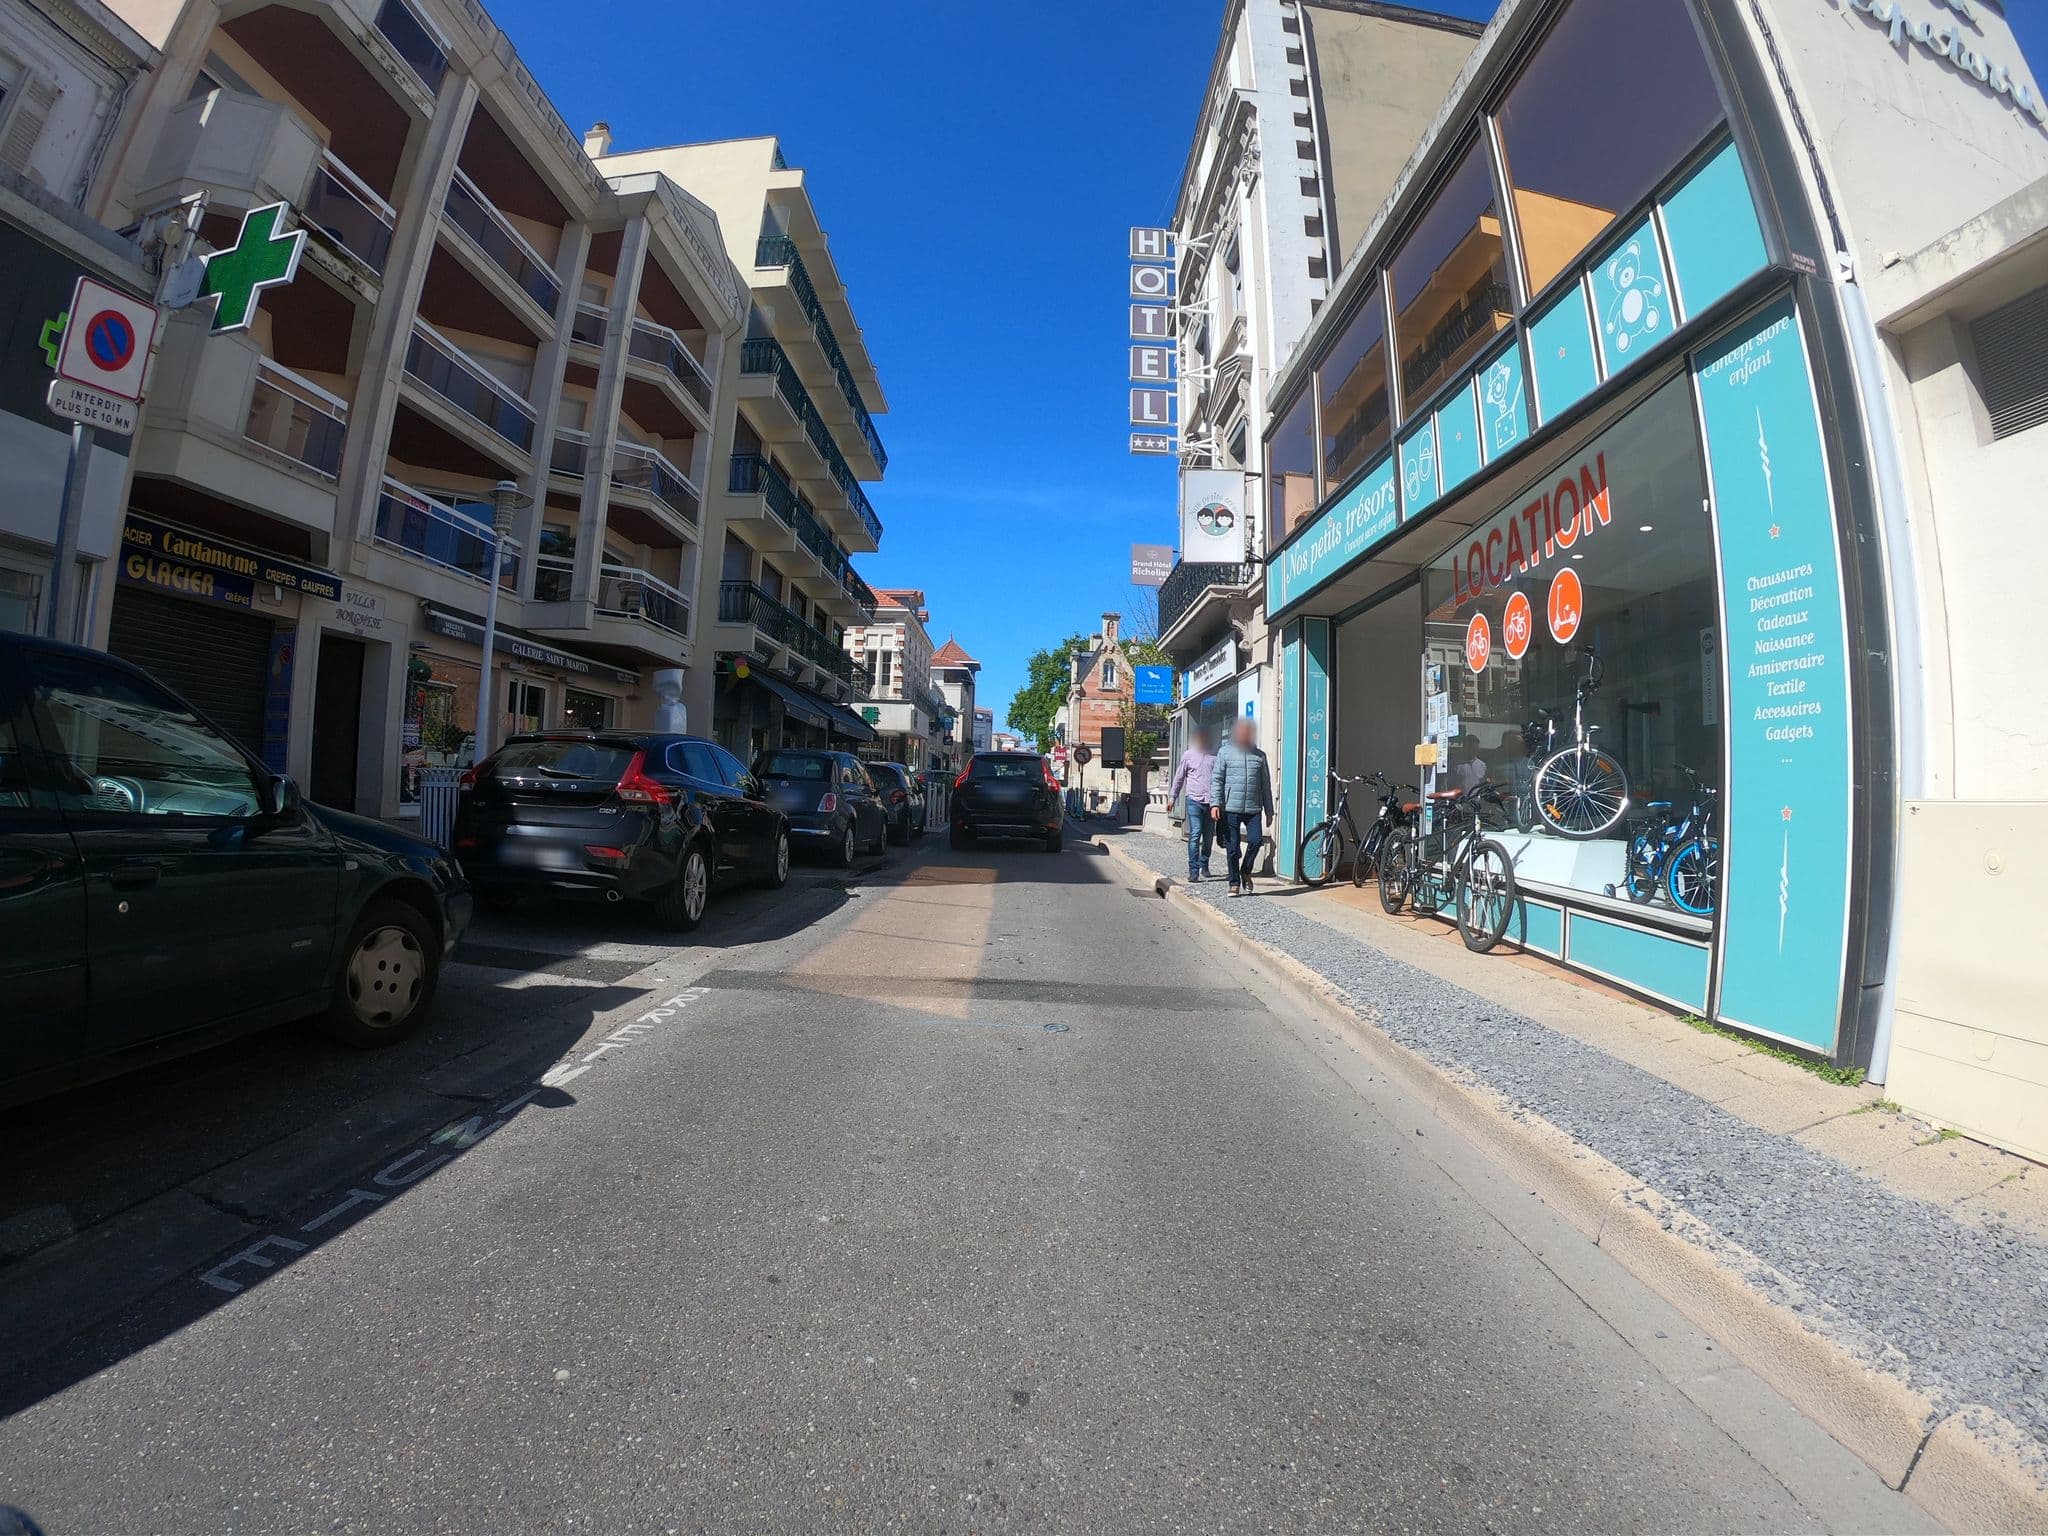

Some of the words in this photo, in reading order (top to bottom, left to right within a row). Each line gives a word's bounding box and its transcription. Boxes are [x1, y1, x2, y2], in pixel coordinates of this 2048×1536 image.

[1135, 230, 1165, 420] HOTEL
[1703, 339, 1753, 378] Concept
[1757, 316, 1790, 346] store
[1729, 349, 1772, 386] enfant
[56, 398, 81, 414] PLUS
[84, 407, 98, 419] DE
[101, 413, 112, 424] 10
[115, 417, 130, 429] MN
[71, 389, 122, 413] INTERDIT
[1286, 542, 1309, 584] Nos
[1310, 517, 1342, 574] petits
[1345, 476, 1395, 536] trésors
[1452, 450, 1612, 608] LOCATION
[127, 554, 214, 597] GLACIER
[162, 531, 258, 576] Cardamome
[265, 568, 297, 587] CREPES
[301, 579, 335, 598] GAUFRES
[1747, 563, 1813, 592] Chaussures
[346, 592, 377, 610] VILLA
[1750, 586, 1813, 613] Décoration
[1757, 610, 1809, 632] Cadeaux
[512, 642, 543, 661] GALERIE
[546, 651, 565, 668] SAINT
[566, 659, 589, 673] MARTIN
[1755, 632, 1815, 655] Naissance
[1748, 653, 1825, 678] Anniversaire
[1766, 678, 1806, 697] Textile
[1754, 700, 1822, 720] Accessoires
[1766, 724, 1814, 743] Gadgets
[502, 780, 577, 790] VOLVO
